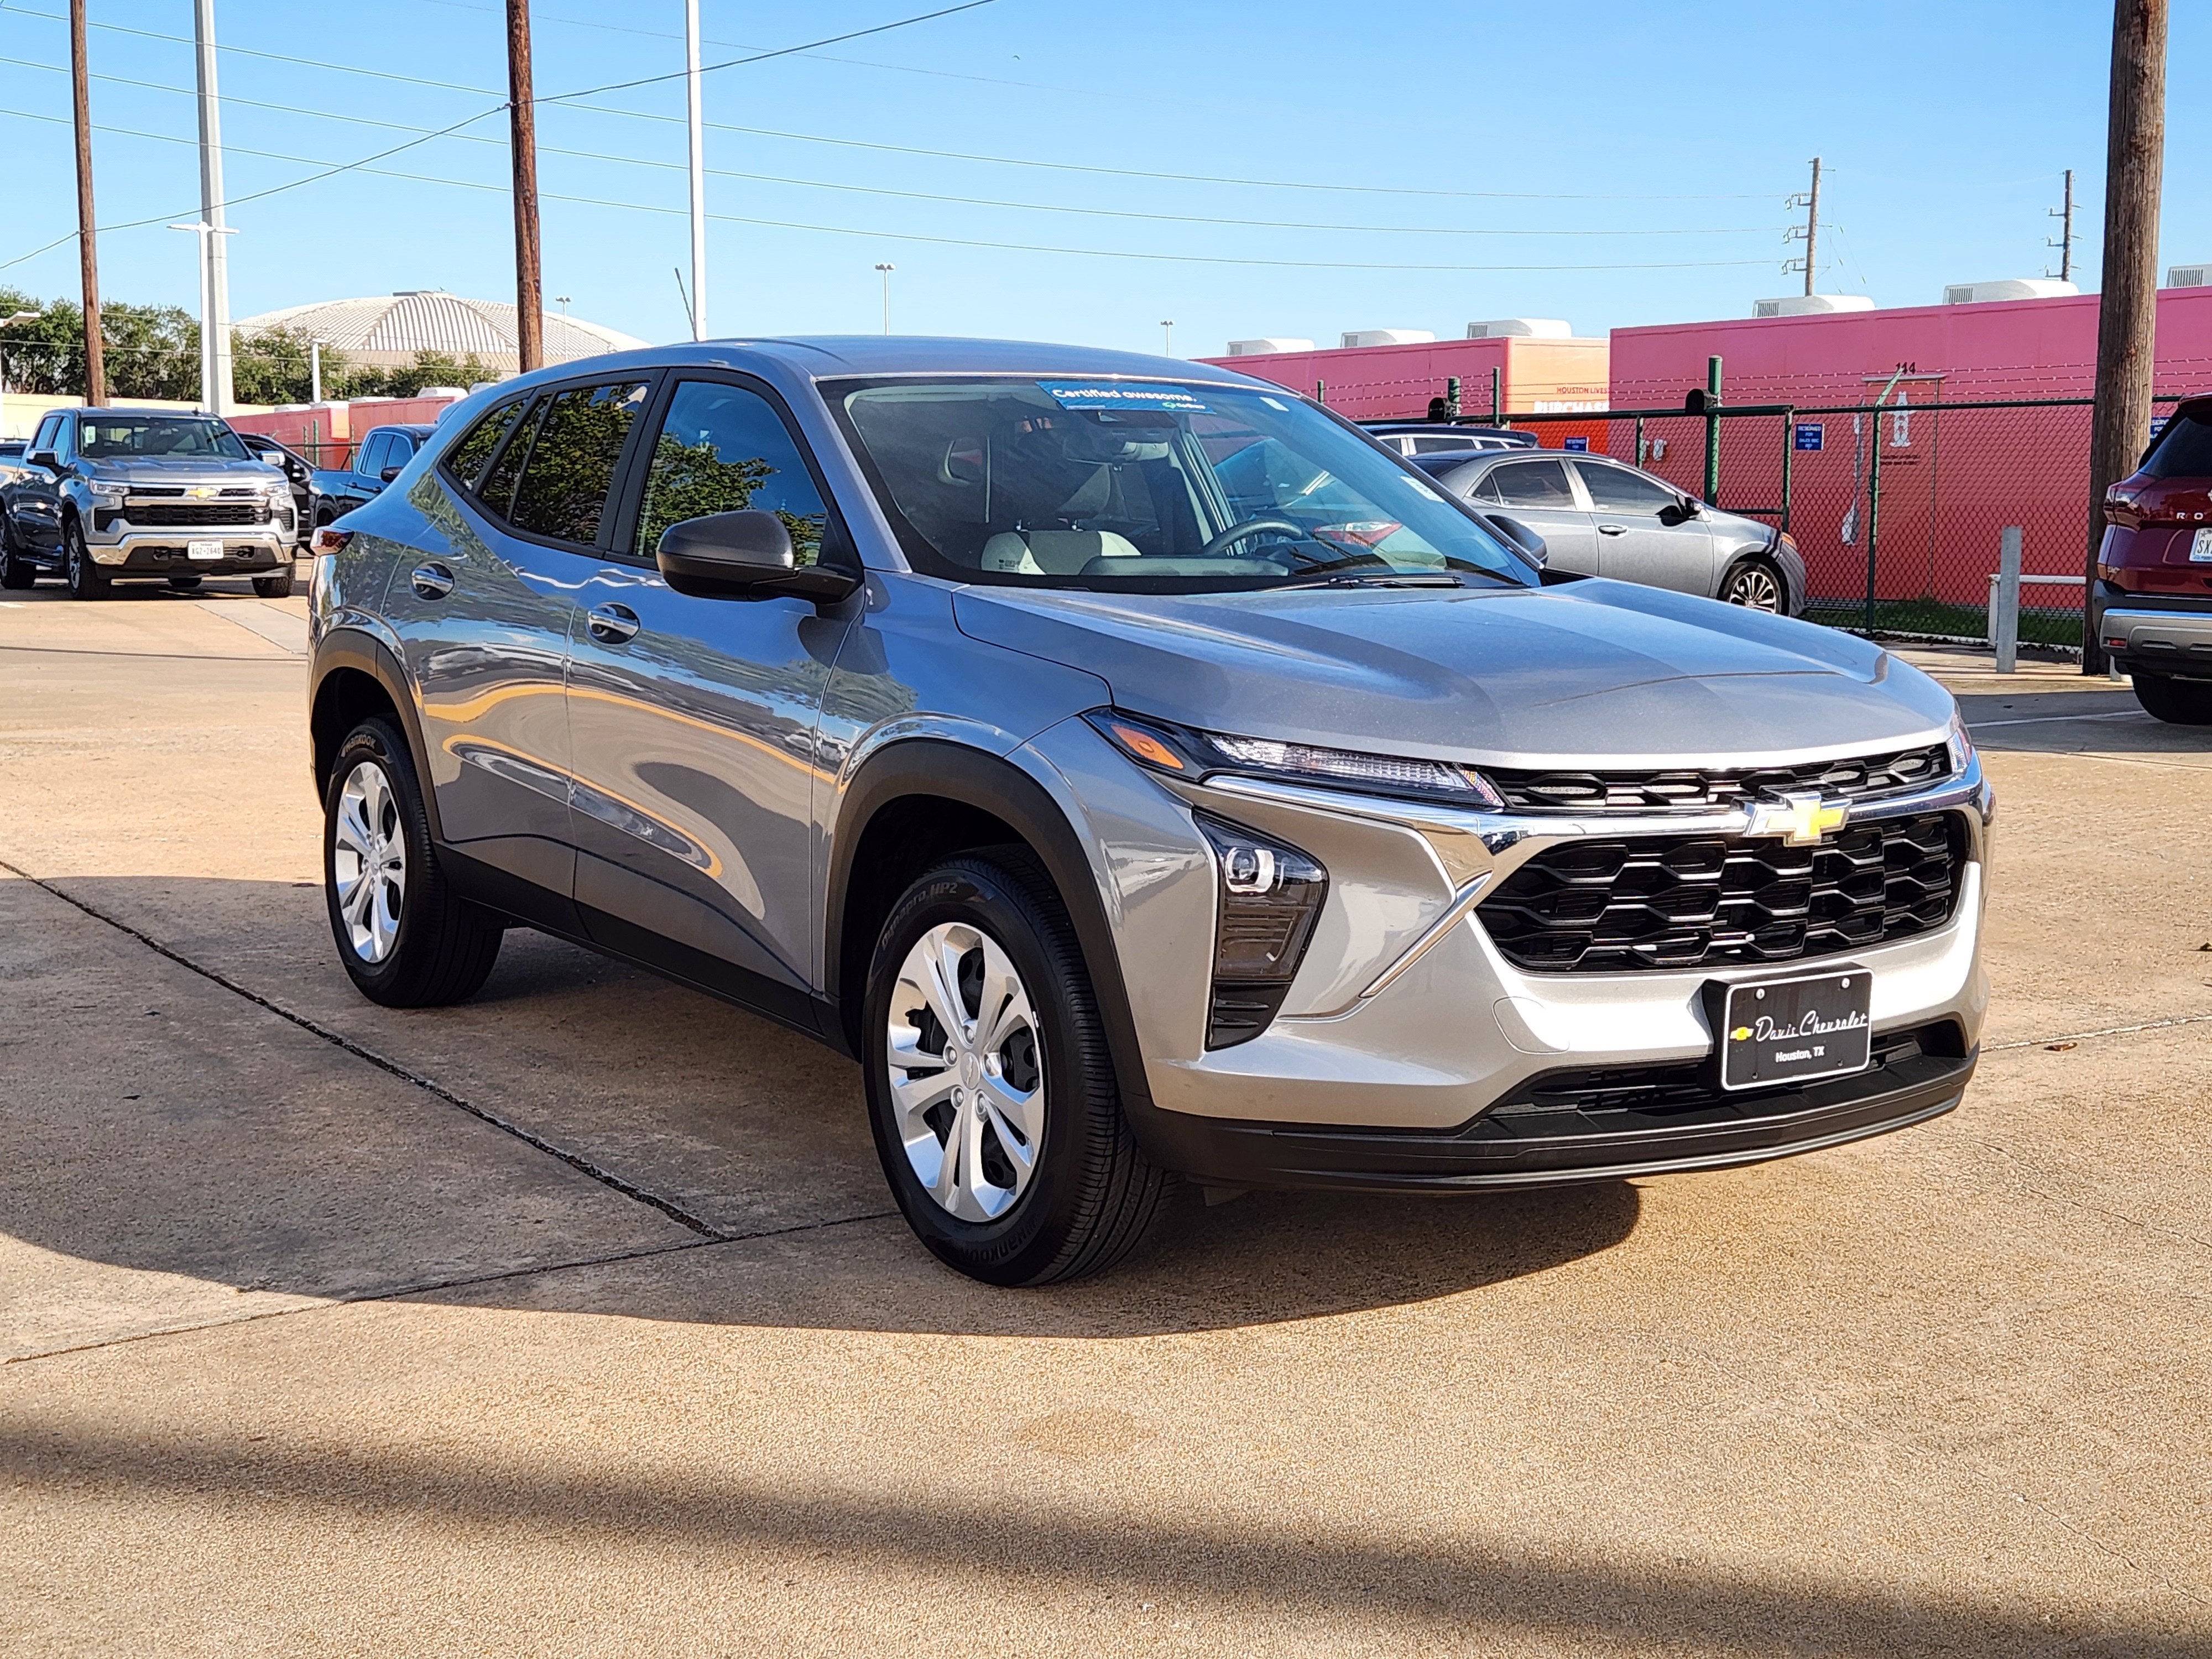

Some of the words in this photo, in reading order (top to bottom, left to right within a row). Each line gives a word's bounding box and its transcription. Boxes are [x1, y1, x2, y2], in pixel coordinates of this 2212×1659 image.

[930, 882, 958, 896] HP2
[1756, 1016, 1799, 1042] Davis
[1799, 1010, 1867, 1036] Chevrolet
[1776, 1050, 1812, 1063] Houston,
[1813, 1046, 1824, 1057] TX
